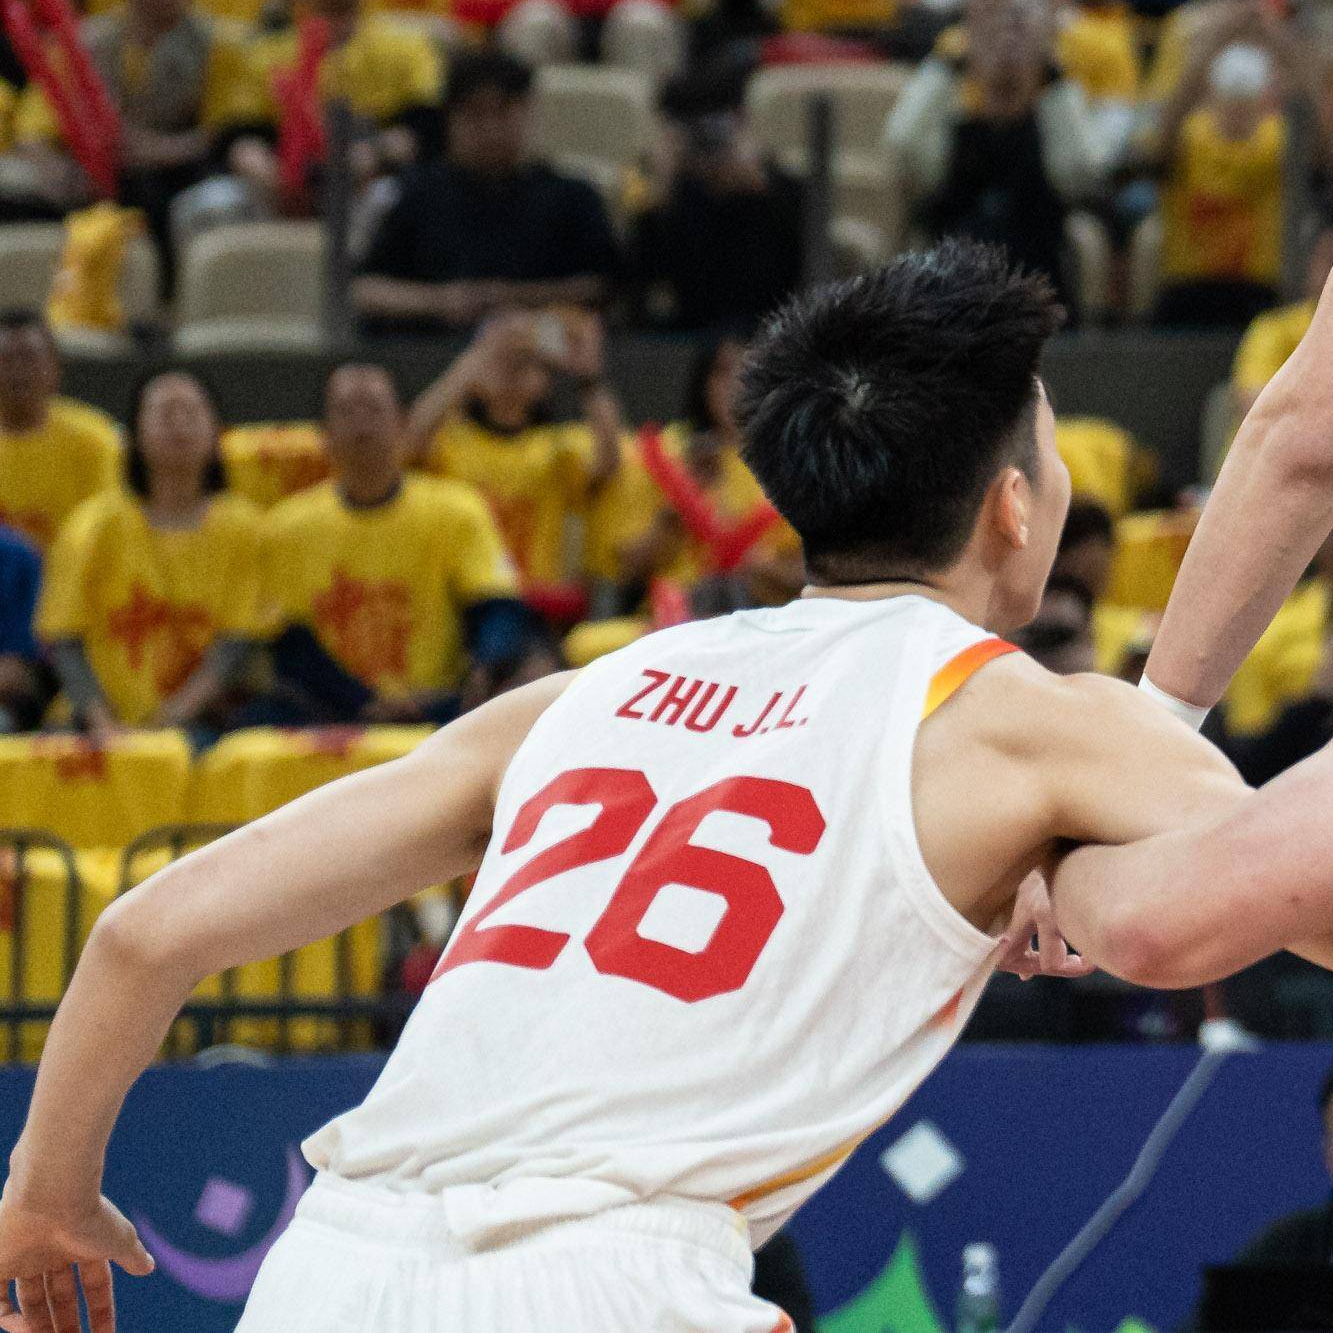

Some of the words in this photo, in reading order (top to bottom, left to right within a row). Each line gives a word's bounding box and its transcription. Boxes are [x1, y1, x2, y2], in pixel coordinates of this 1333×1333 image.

[614, 668, 740, 734] ZHU
[731, 683, 810, 739] J.L.
[426, 766, 827, 1004] 26
